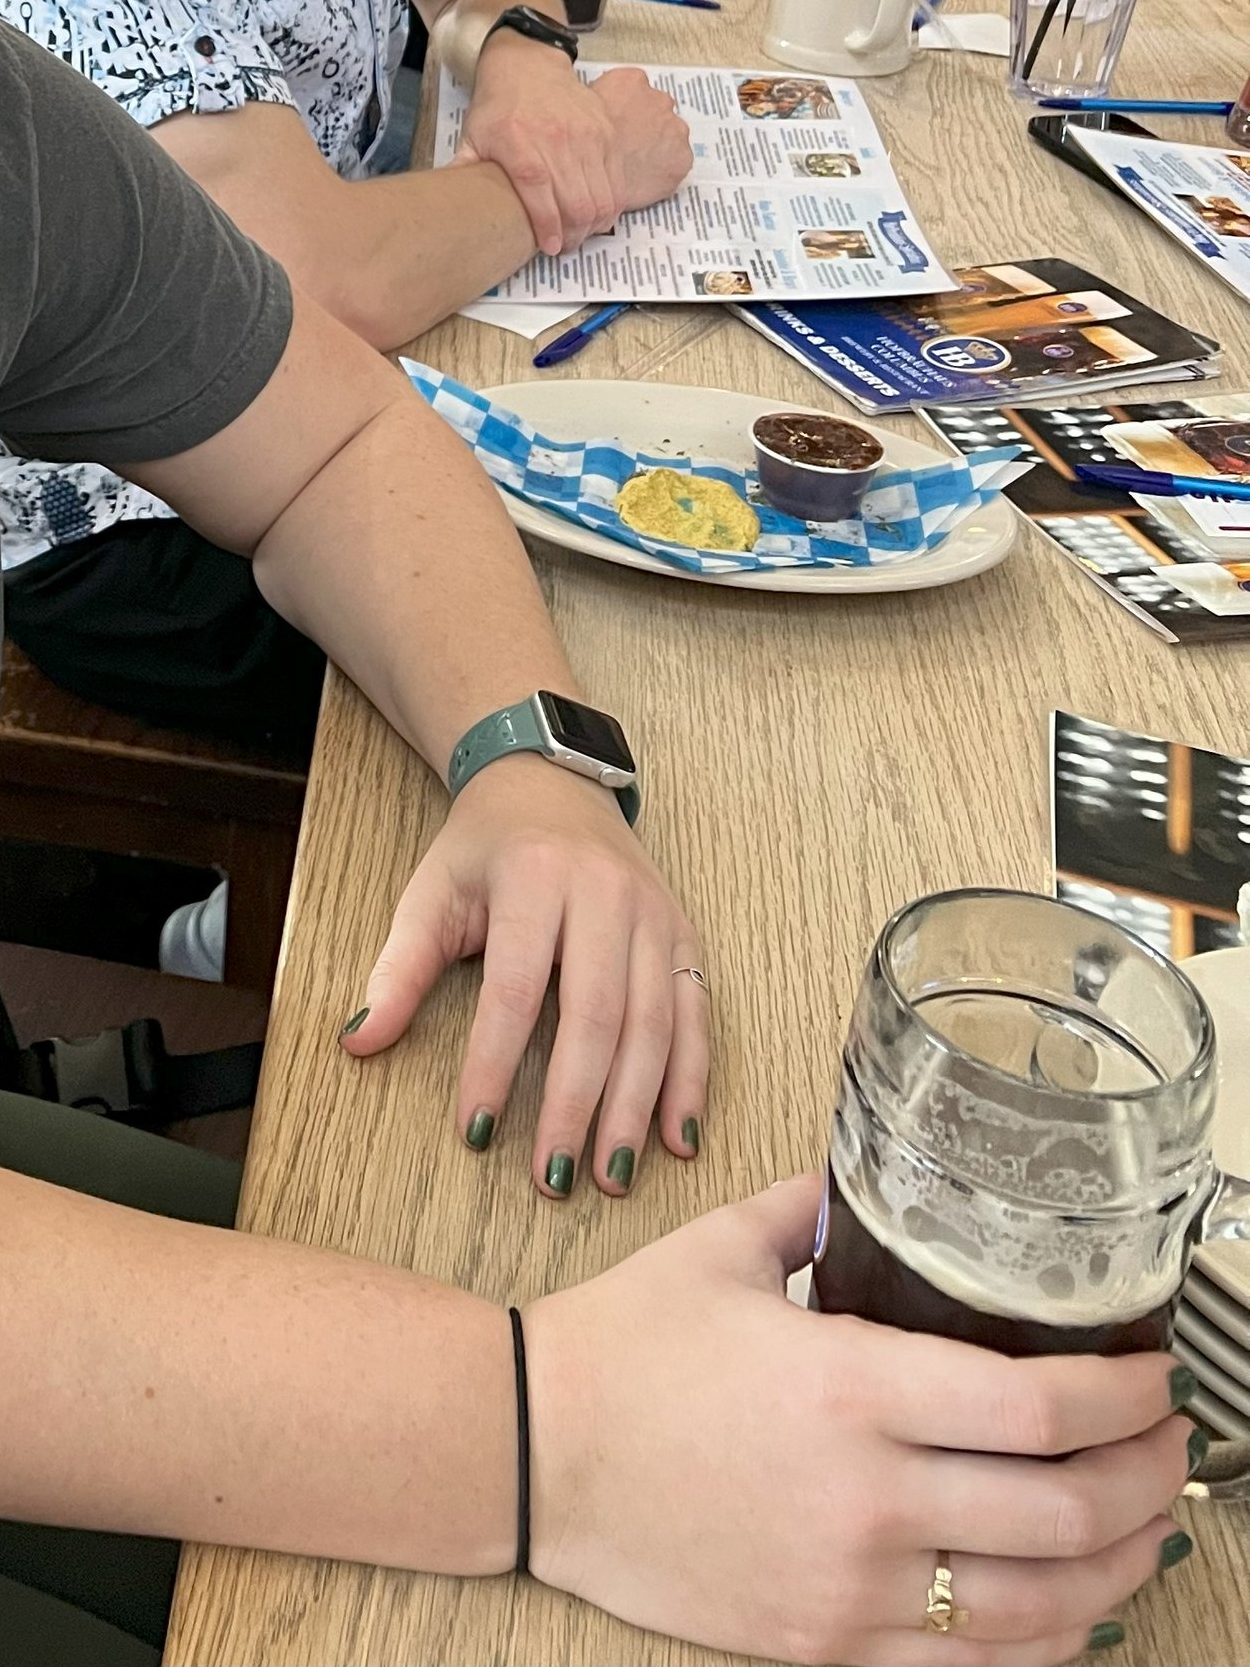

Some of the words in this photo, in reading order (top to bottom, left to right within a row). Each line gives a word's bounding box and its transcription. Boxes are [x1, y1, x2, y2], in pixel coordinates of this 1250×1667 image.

[766, 302, 815, 335] RINKS
[818, 345, 901, 397] DESSERTS
[931, 346, 977, 368] HB
